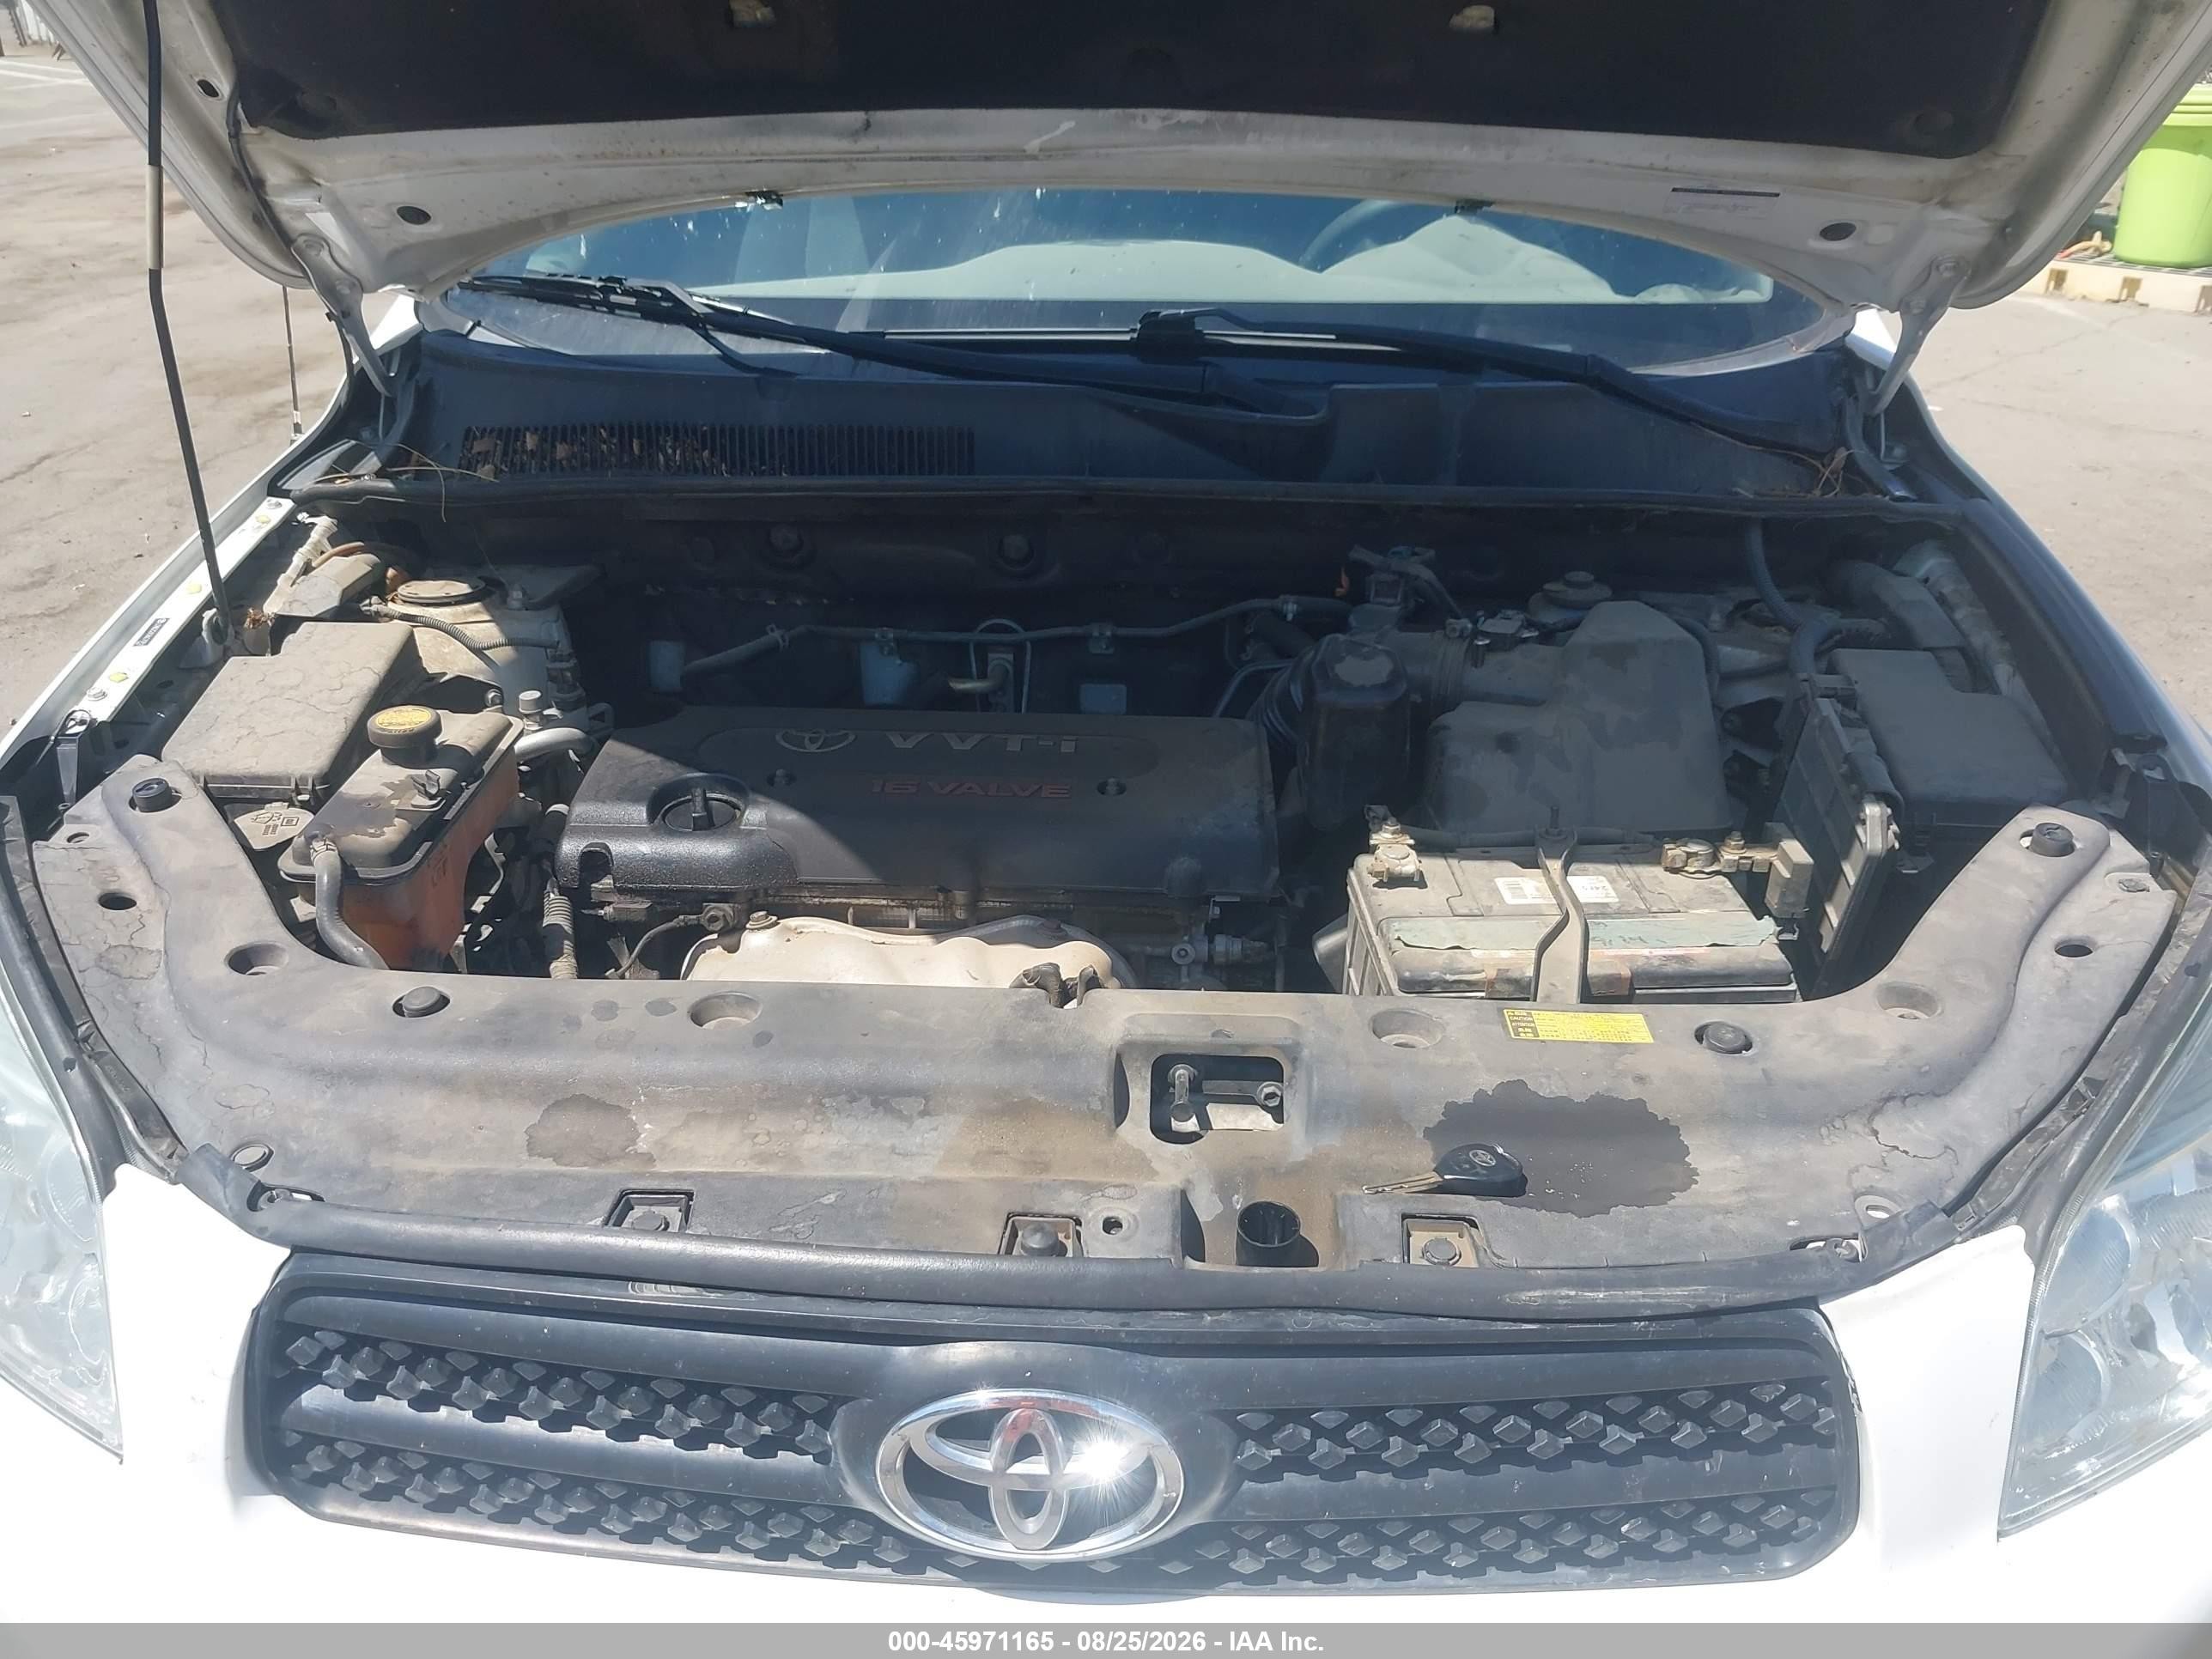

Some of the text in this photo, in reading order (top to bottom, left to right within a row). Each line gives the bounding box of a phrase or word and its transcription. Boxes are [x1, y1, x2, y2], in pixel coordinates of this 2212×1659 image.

[885, 732, 1079, 753] VVT-i
[872, 779, 1073, 798] 16 VALVE
